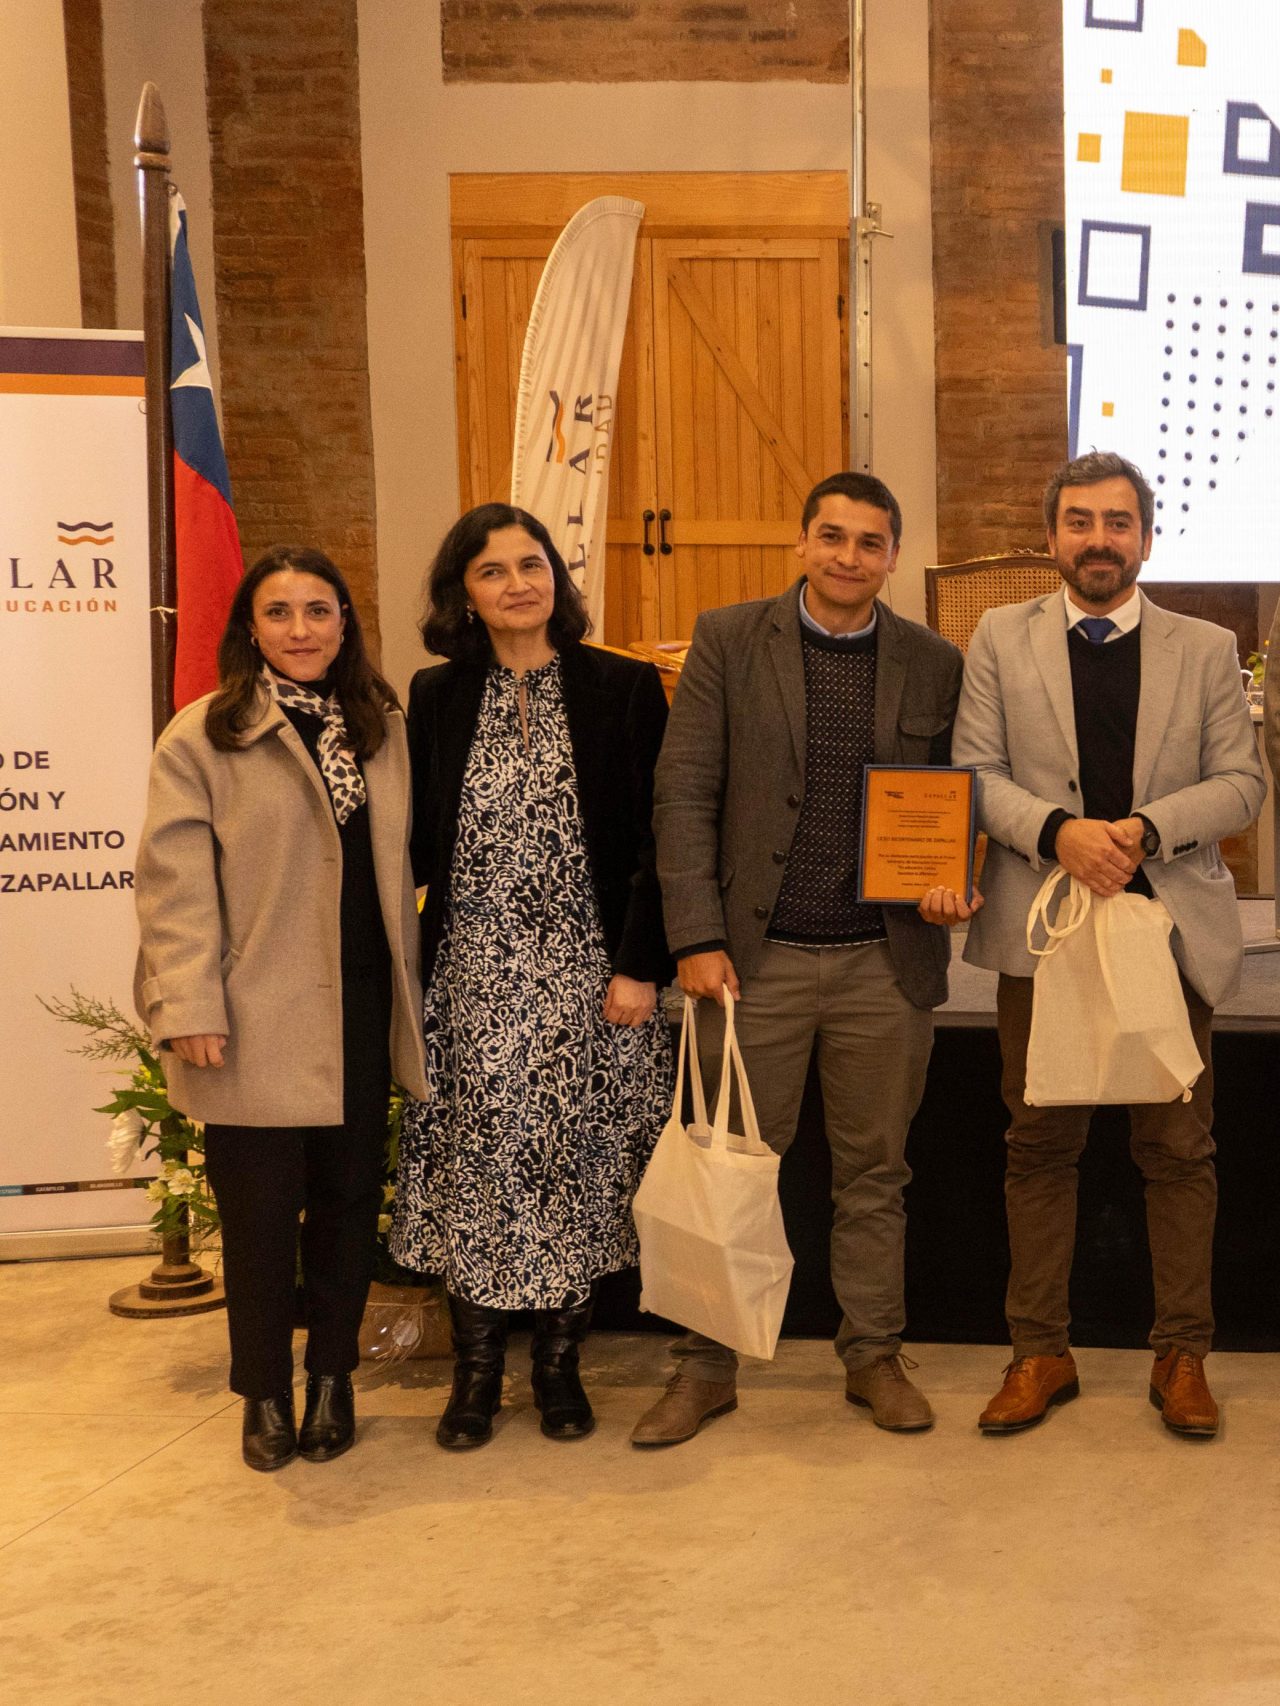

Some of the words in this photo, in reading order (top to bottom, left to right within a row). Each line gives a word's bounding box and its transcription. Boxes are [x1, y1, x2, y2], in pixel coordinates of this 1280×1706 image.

[9, 557, 118, 589] LAR
[6, 597, 118, 613] UCACIÓN
[14, 750, 51, 770] DE
[47, 790, 66, 810] Y
[0, 830, 126, 852] AMIENTO
[1, 870, 136, 894] ZAPALLAR
